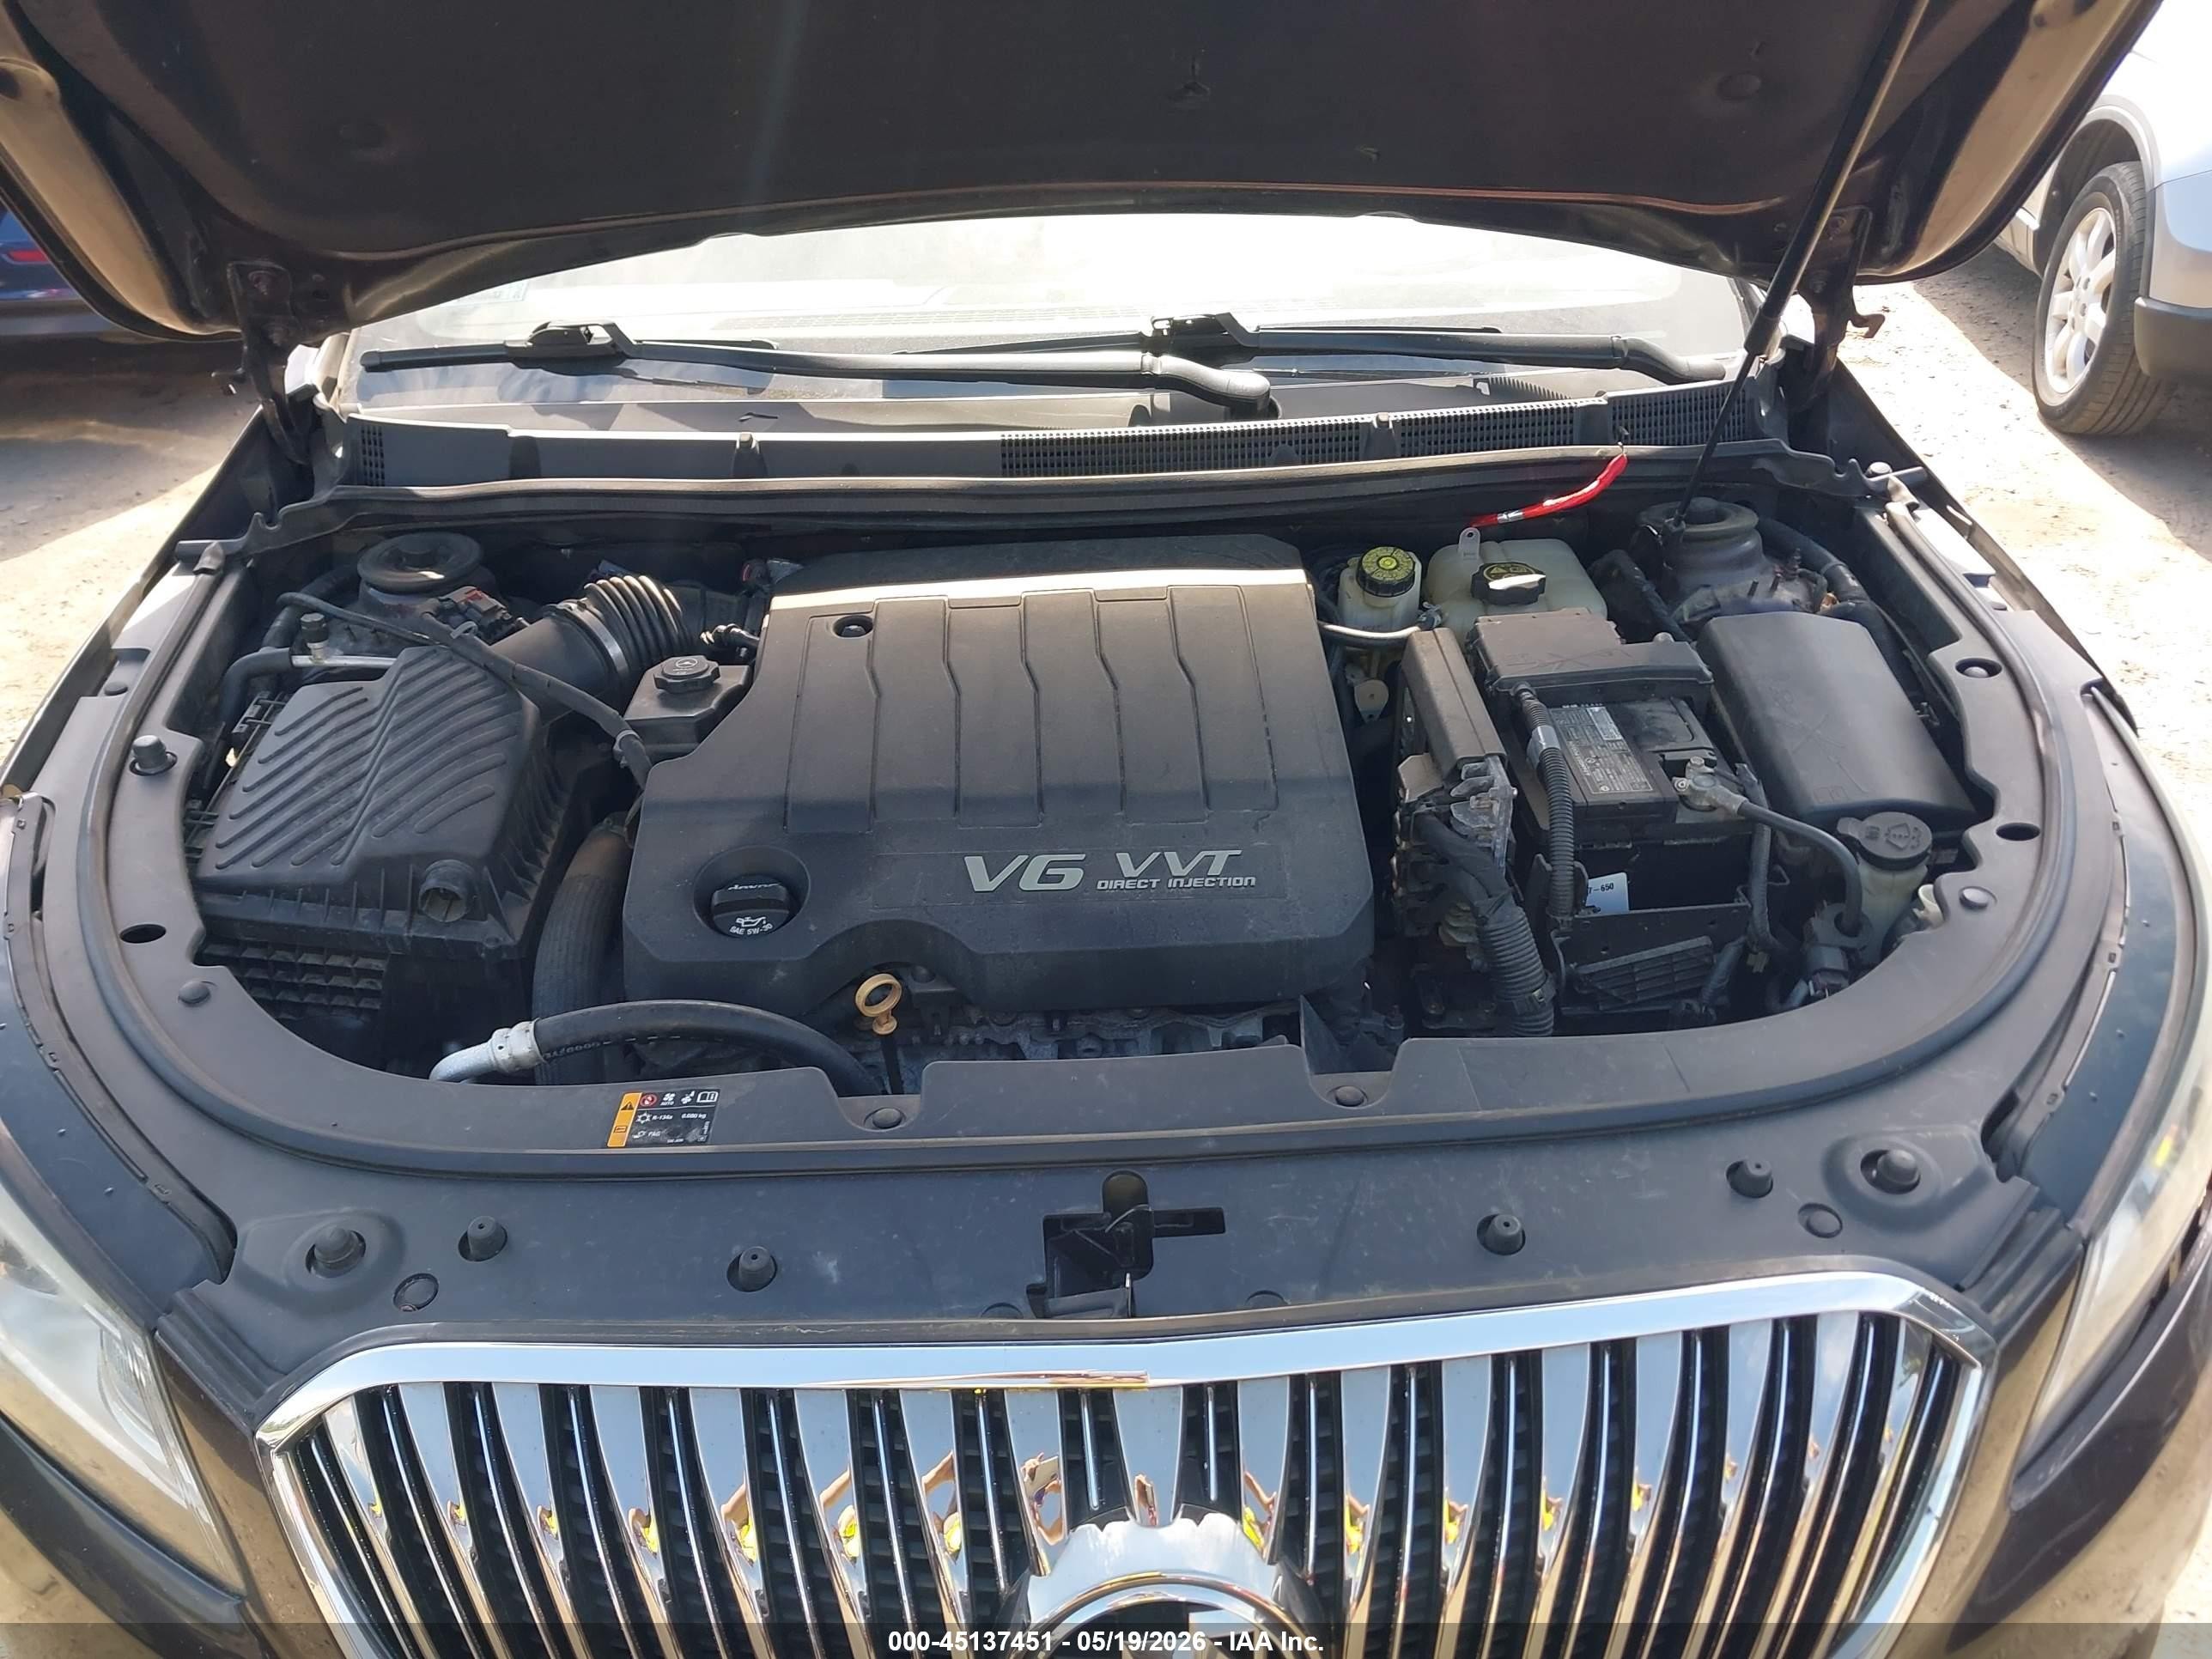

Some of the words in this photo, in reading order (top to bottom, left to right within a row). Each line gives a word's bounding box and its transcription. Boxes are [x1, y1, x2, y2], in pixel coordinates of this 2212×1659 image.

[963, 854, 1086, 891] V6
[1115, 849, 1243, 878] VVT
[1096, 878, 1161, 890] DIRECT
[1167, 876, 1256, 889] INJECTION
[729, 925, 745, 935] SAE
[746, 923, 774, 935] 5W-30
